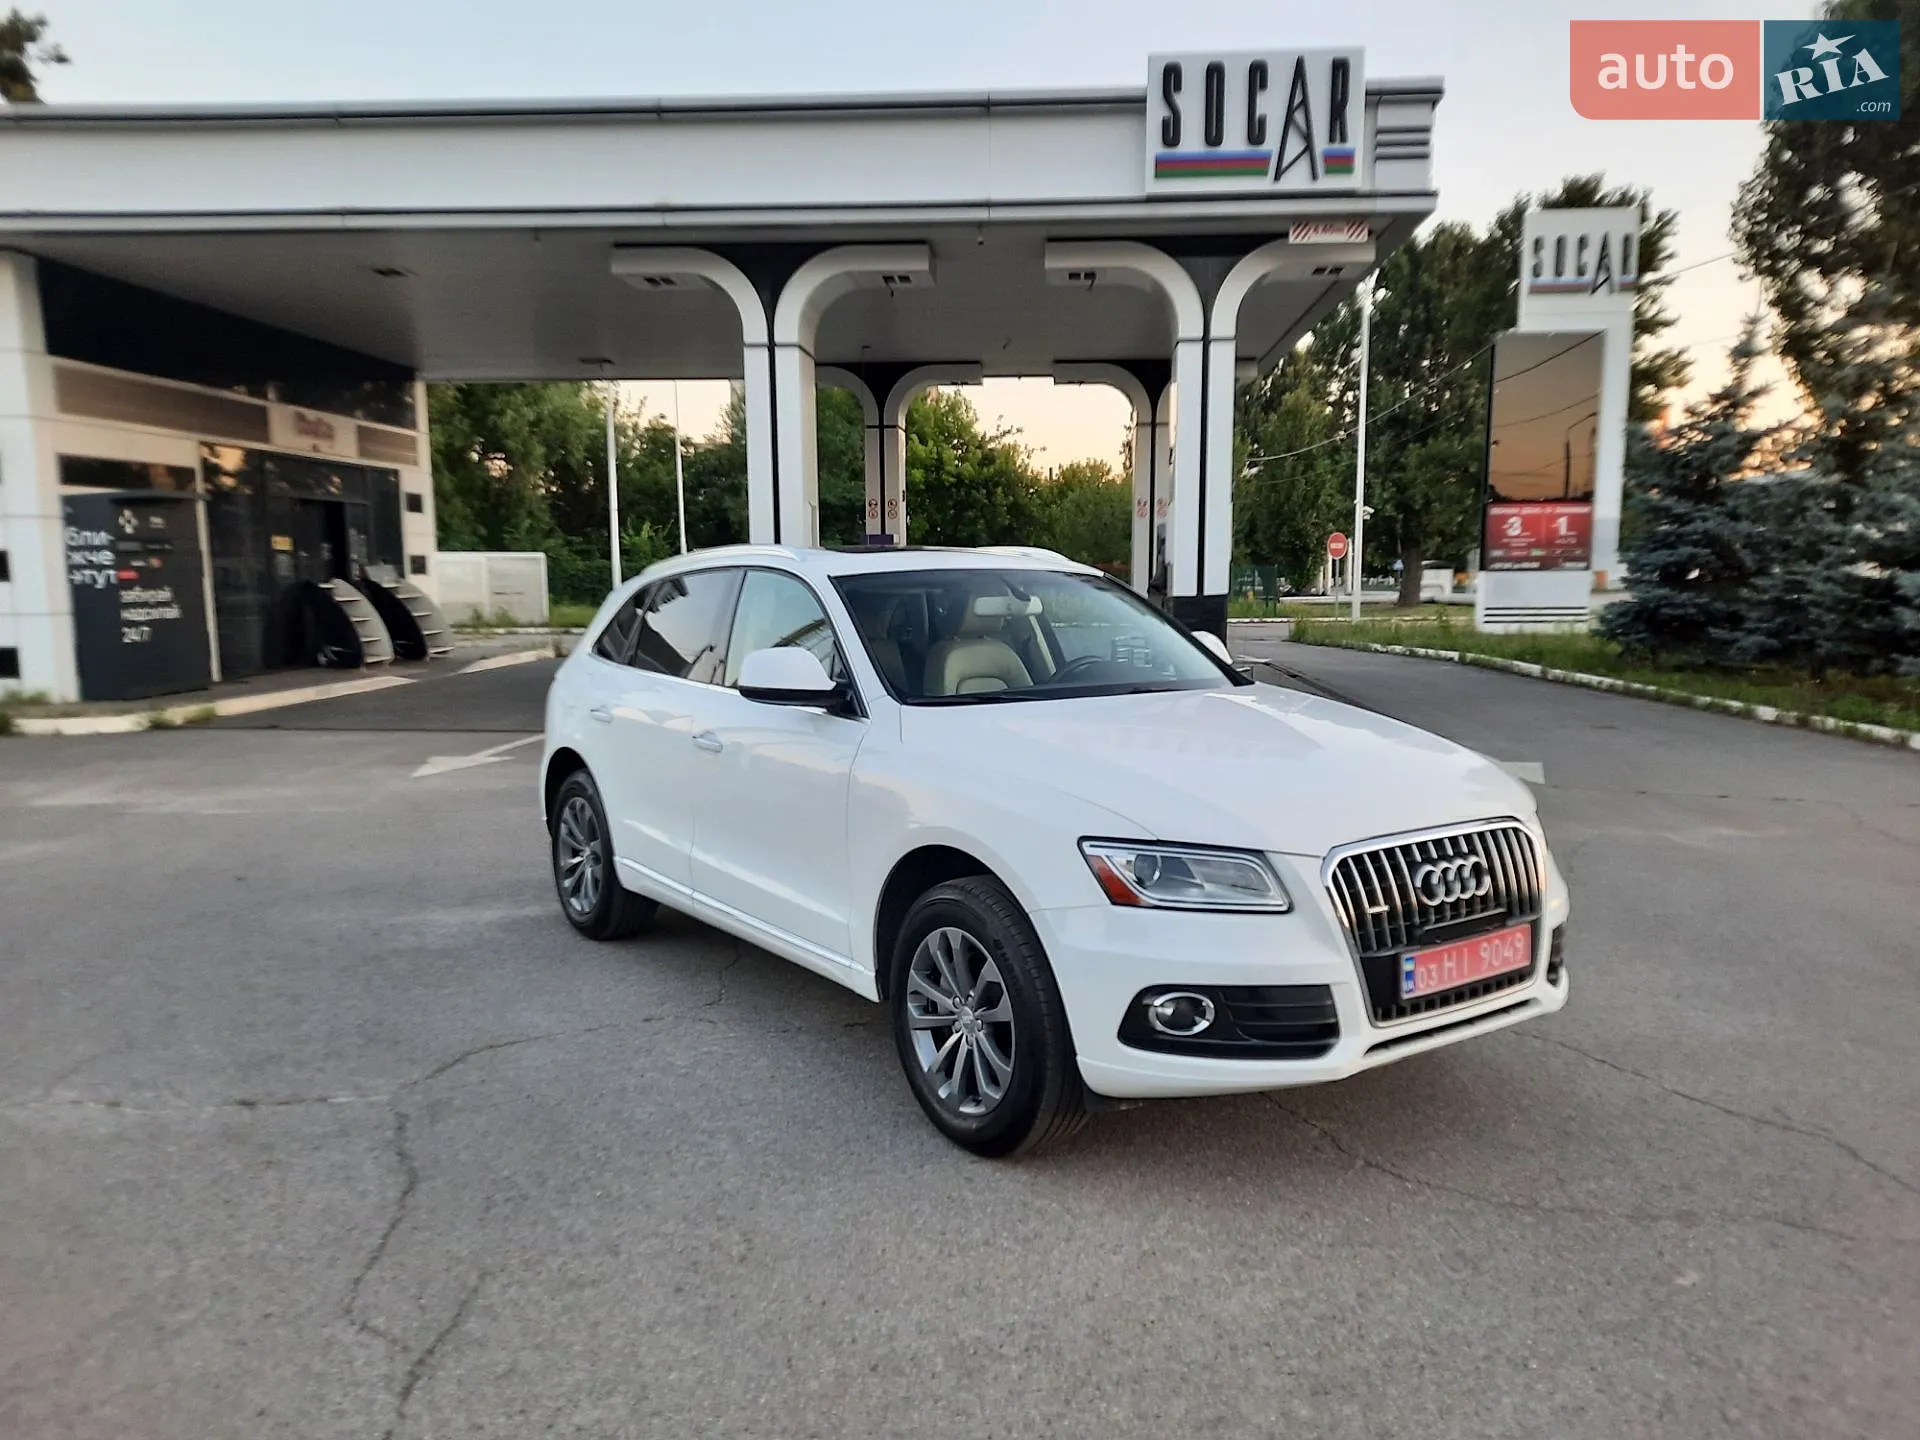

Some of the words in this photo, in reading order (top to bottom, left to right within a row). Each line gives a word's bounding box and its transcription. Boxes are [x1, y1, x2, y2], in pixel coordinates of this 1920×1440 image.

[1161, 54, 1351, 183] SOCAR
[1418, 963, 1439, 989] 03
[1480, 931, 1525, 971] 9049
